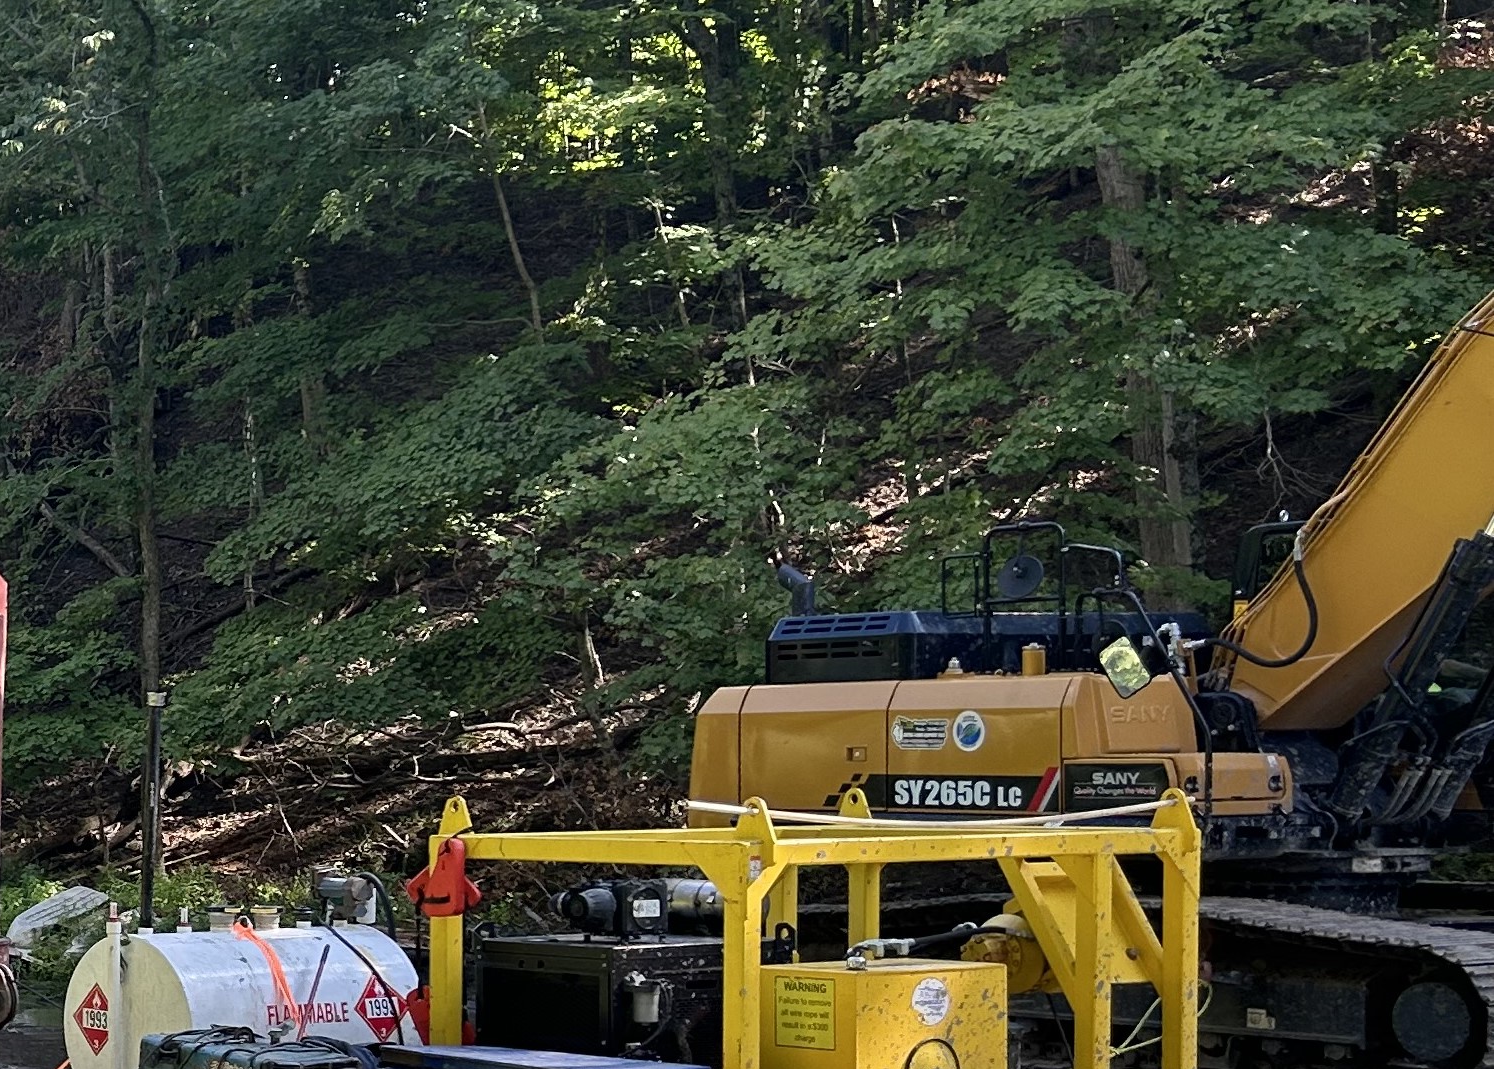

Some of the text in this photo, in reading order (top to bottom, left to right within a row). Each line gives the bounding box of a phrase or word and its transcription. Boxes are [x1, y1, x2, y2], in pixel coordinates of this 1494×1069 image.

[1092, 772, 1140, 785] SANY
[894, 779, 1023, 807] SY265C LC
[783, 981, 827, 994] WARNING
[85, 1009, 108, 1030] 1993
[381, 1027, 387, 1038] 3
[93, 1039, 99, 1049] 3
